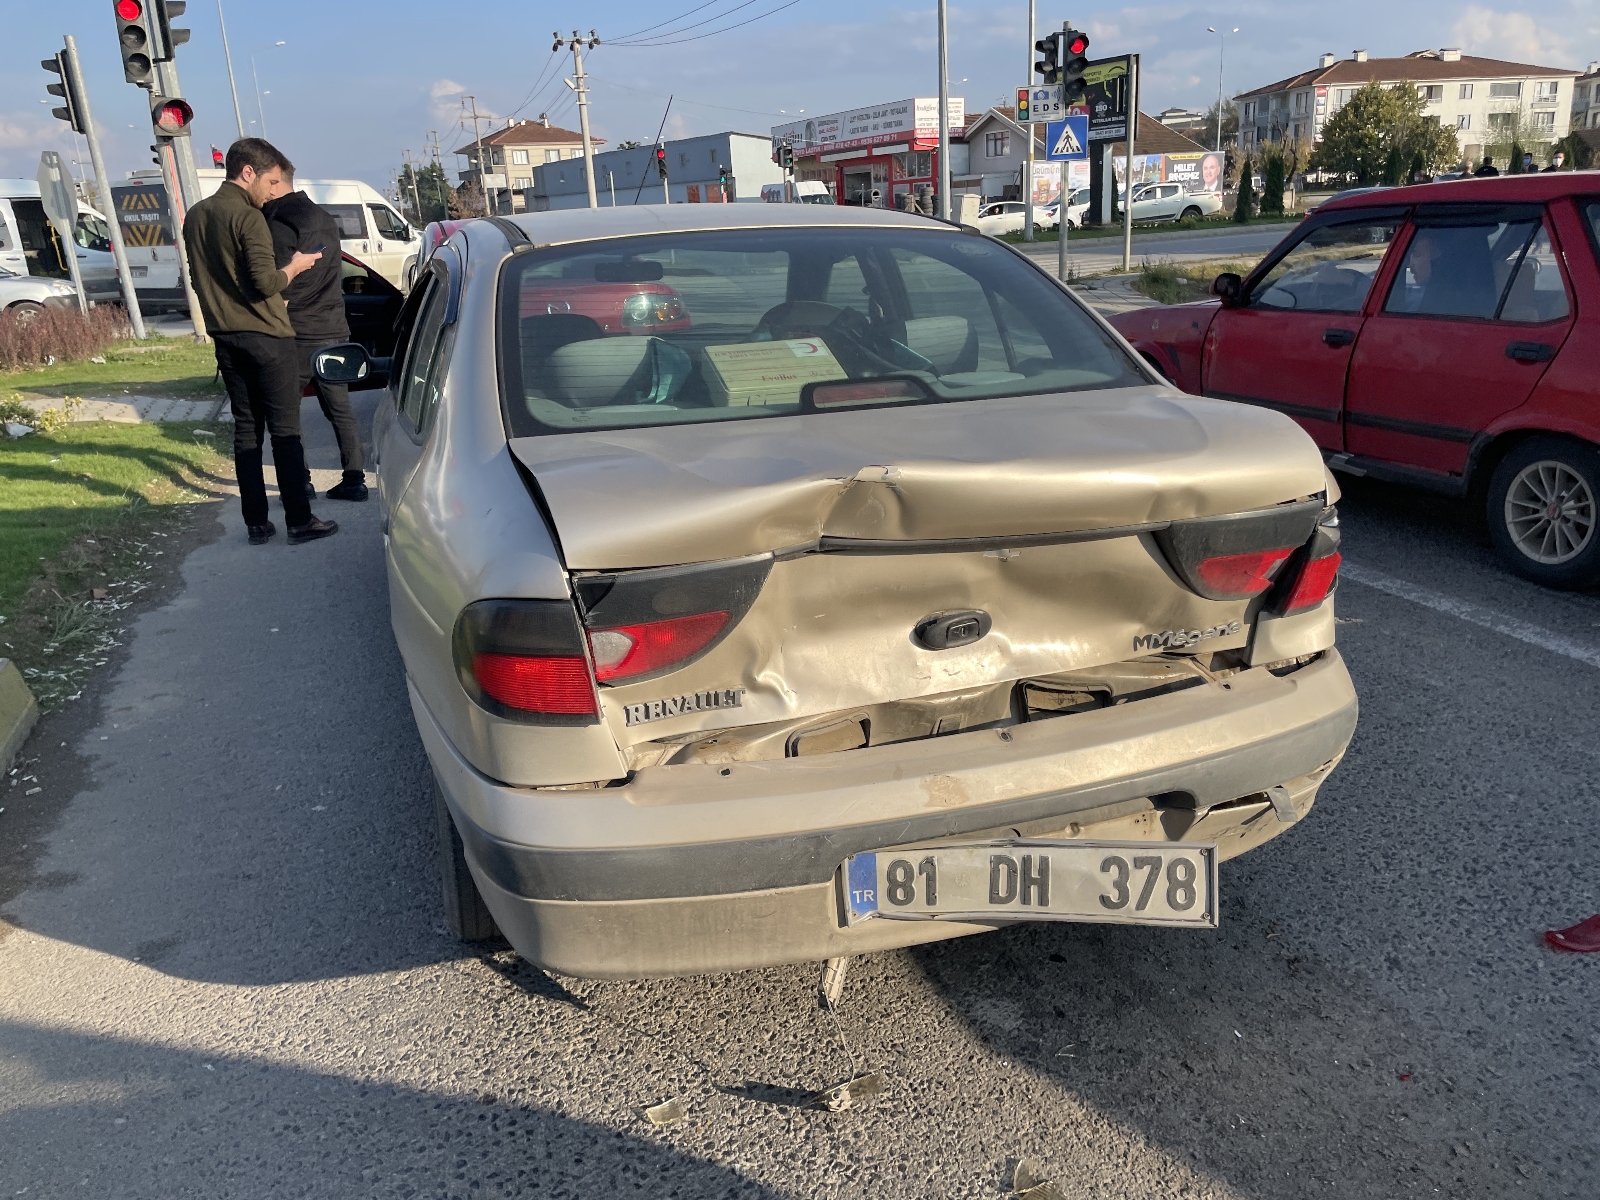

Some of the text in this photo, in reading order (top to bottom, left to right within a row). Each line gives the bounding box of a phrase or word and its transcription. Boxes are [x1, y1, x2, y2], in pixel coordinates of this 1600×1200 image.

[124, 214, 141, 222] OKUL
[623, 688, 746, 728] RENAULT
[886, 854, 1198, 911] 81 DH 378
[853, 889, 875, 904] TR
